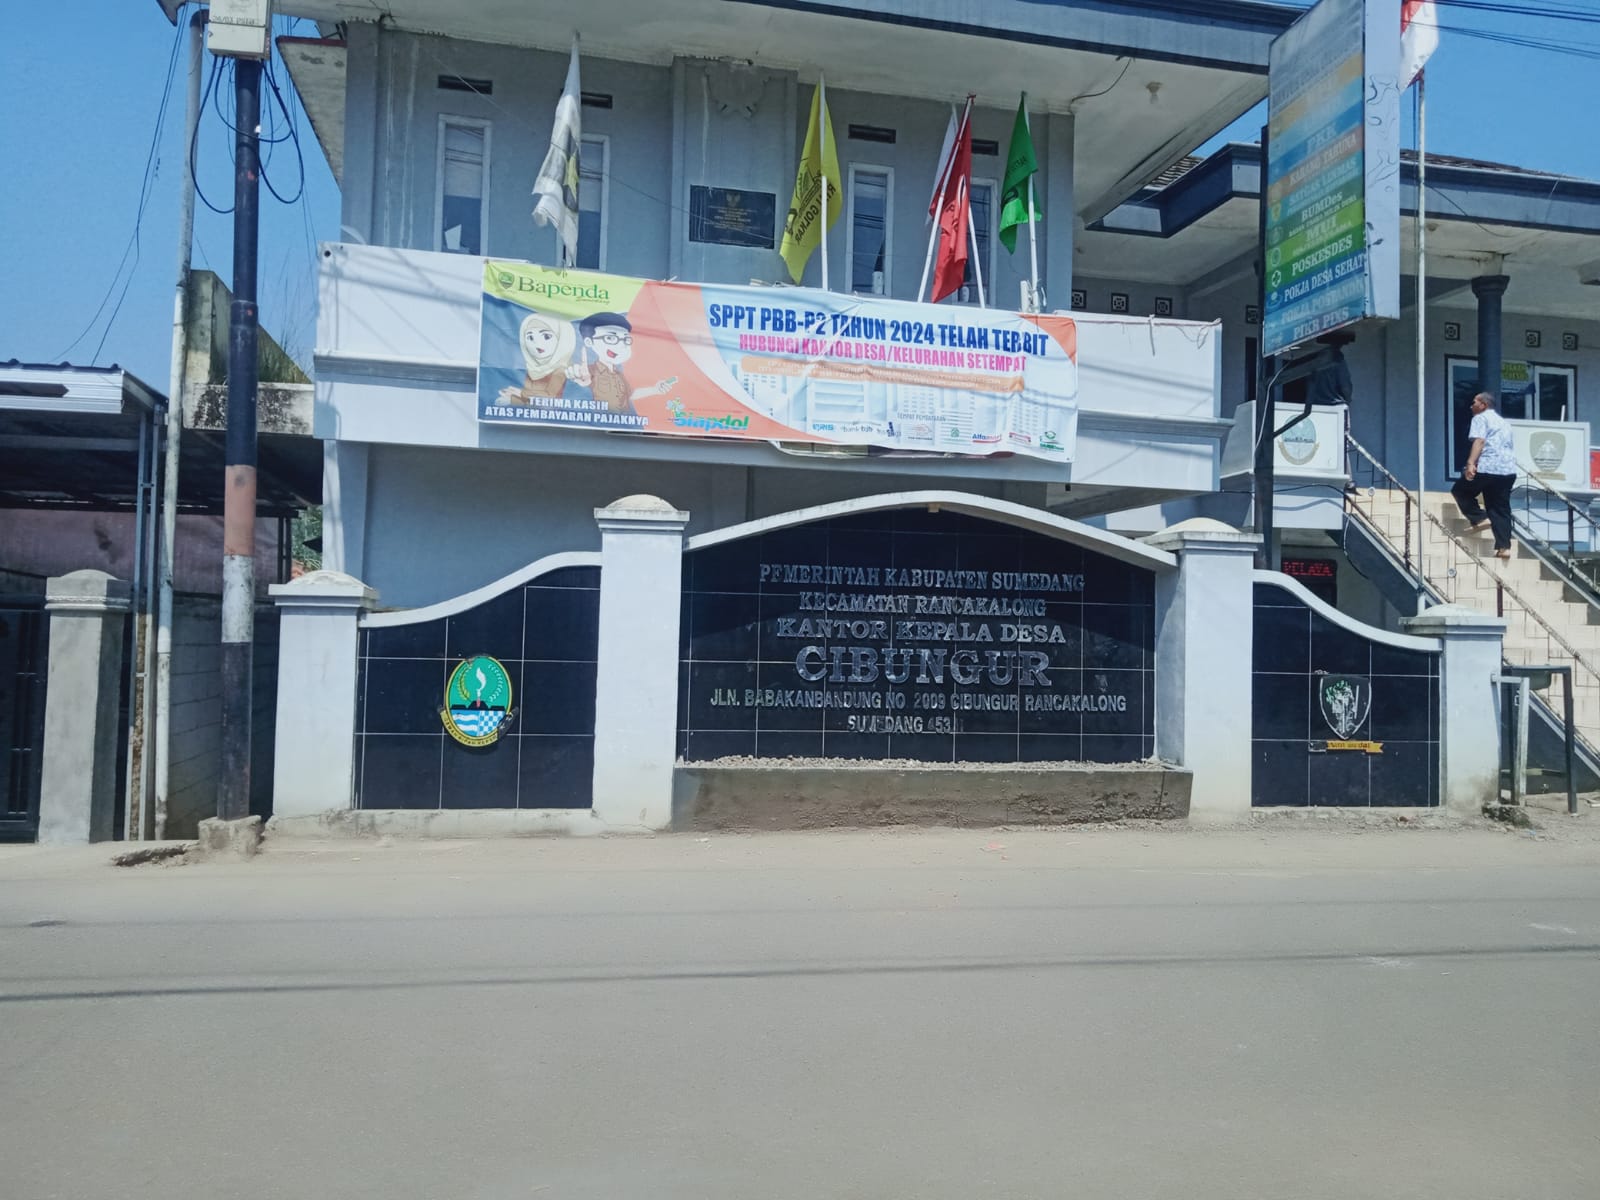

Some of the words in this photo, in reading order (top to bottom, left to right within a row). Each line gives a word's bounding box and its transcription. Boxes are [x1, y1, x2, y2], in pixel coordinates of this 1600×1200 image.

[1301, 191, 1342, 220] BUMDes
[1292, 234, 1353, 276] POSKESDES
[518, 275, 609, 299] Bapenda
[1284, 280, 1309, 302] POKJA
[1311, 269, 1333, 289] DESA
[1335, 254, 1365, 279] SEHAT
[709, 303, 756, 330] SPPT
[760, 307, 827, 336] PBB-P2
[832, 313, 886, 342] TAHUN
[890, 318, 935, 345] 2024
[938, 323, 989, 350] TELAH
[992, 328, 1049, 356] TERBIT
[739, 333, 799, 354] HUBUNGI
[855, 342, 964, 368] DESA/KELURAHAN
[967, 352, 1027, 372] SETEMPAT
[485, 406, 514, 418] ATAS
[516, 408, 592, 422] PEMBAYARAN
[594, 414, 649, 426] PAJAKNYA
[528, 396, 572, 409] TERIMA
[574, 399, 609, 411] KASIH
[760, 563, 880, 586] PEMERINTAH
[884, 567, 988, 589] KABUPATEN
[991, 571, 1085, 592] SUMEDANG
[799, 591, 908, 614] KECAMATAN
[915, 595, 1047, 617] RANCAKALONG
[777, 617, 888, 640] KANTOR
[896, 621, 993, 642] KEPALA
[1000, 623, 1066, 644] DESA
[795, 645, 1052, 686] CIBUNGUR
[710, 688, 740, 706] JLN.
[744, 689, 882, 709] BABAKANBANDUNG
[951, 693, 1018, 711] CIBUNGUR
[1025, 694, 1127, 713] RANCAKALONG
